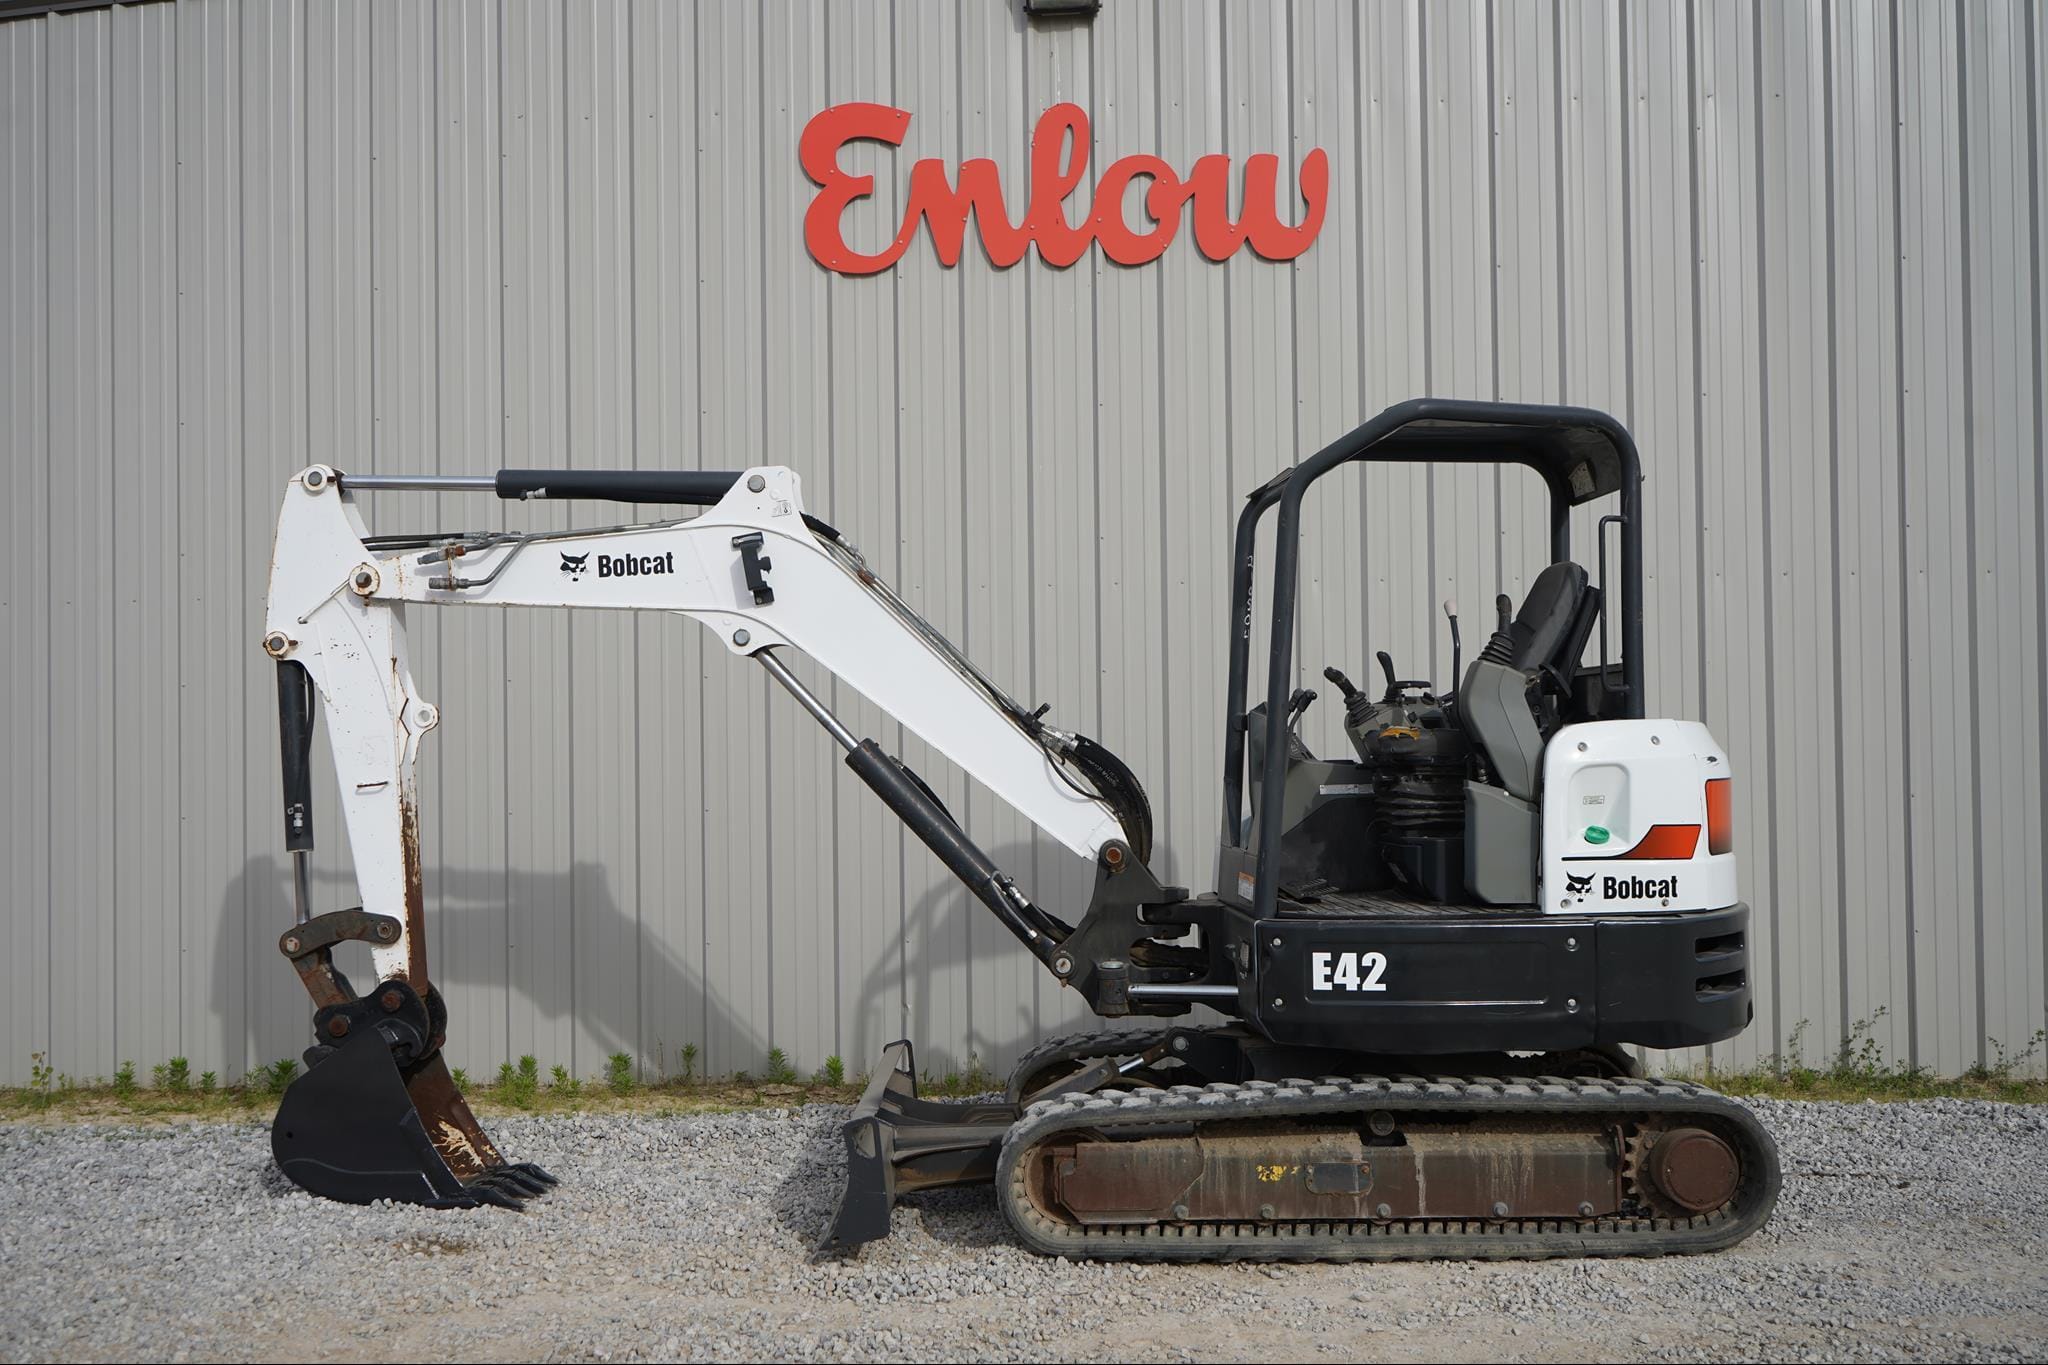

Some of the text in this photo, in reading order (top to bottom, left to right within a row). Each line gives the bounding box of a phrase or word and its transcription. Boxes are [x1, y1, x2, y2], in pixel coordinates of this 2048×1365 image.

[799, 102, 1329, 274] Enlow
[597, 551, 674, 578] Bobcat
[1603, 875, 1678, 899] Bobcat
[1312, 951, 1387, 992] E42
